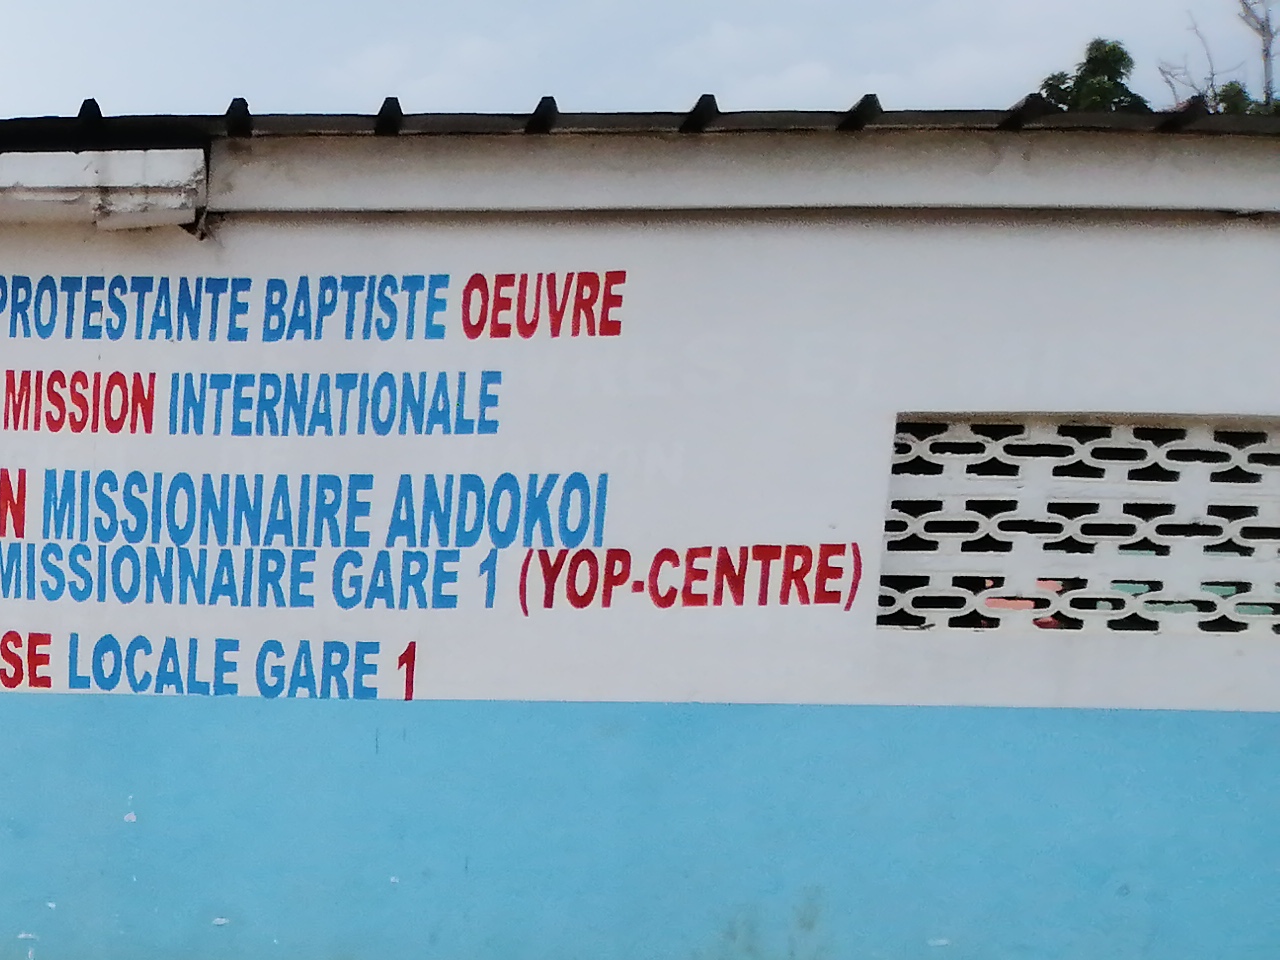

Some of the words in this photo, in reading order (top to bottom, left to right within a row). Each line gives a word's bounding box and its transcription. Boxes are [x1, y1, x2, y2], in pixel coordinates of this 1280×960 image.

[261, 274, 451, 343] BAPTISTE
[460, 270, 627, 340] OEUVRE
[3, 370, 157, 435] MISSION
[168, 371, 503, 437] INTERNATIONALE
[41, 469, 375, 547] MISSIONNAIRE
[384, 472, 609, 549] ANDOKOI
[331, 549, 461, 610] GARE
[478, 548, 499, 609] 1
[68, 633, 241, 696] LOCALE
[255, 639, 381, 700] GARE
[397, 641, 417, 701] 1
